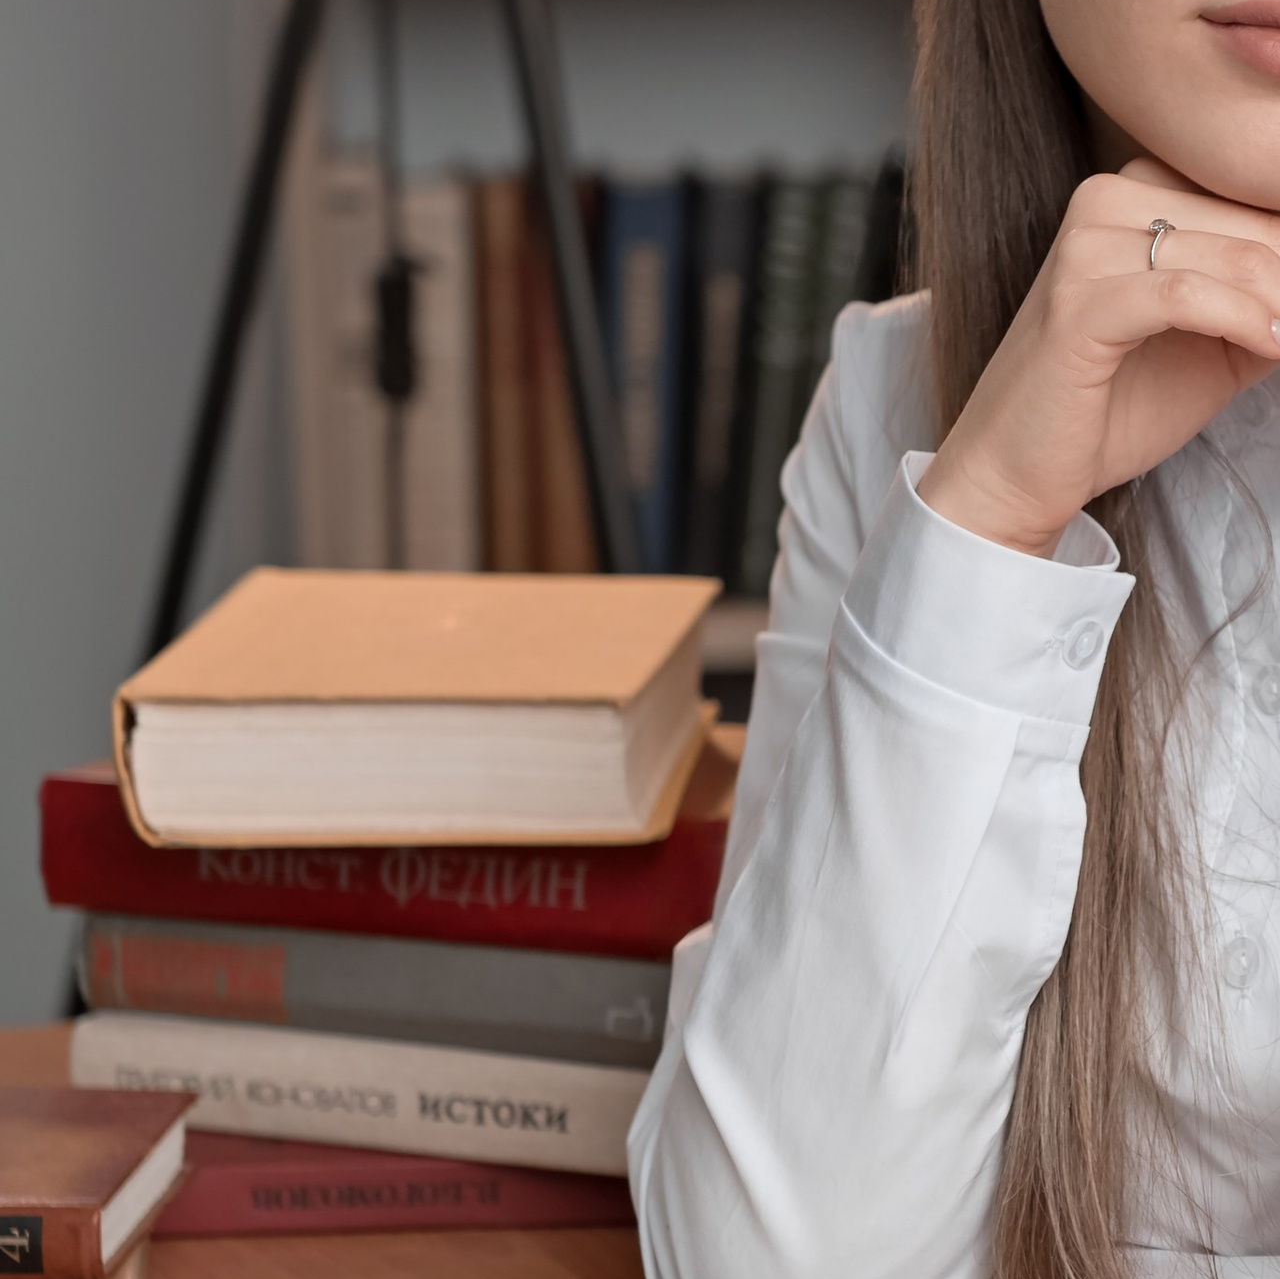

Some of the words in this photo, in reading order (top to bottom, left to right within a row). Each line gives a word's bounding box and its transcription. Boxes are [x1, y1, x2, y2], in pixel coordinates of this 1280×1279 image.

[378, 846, 590, 910] ФЕДИН
[417, 1090, 570, 1135] ИСТОКИ
[0, 1226, 30, 1264] 4
